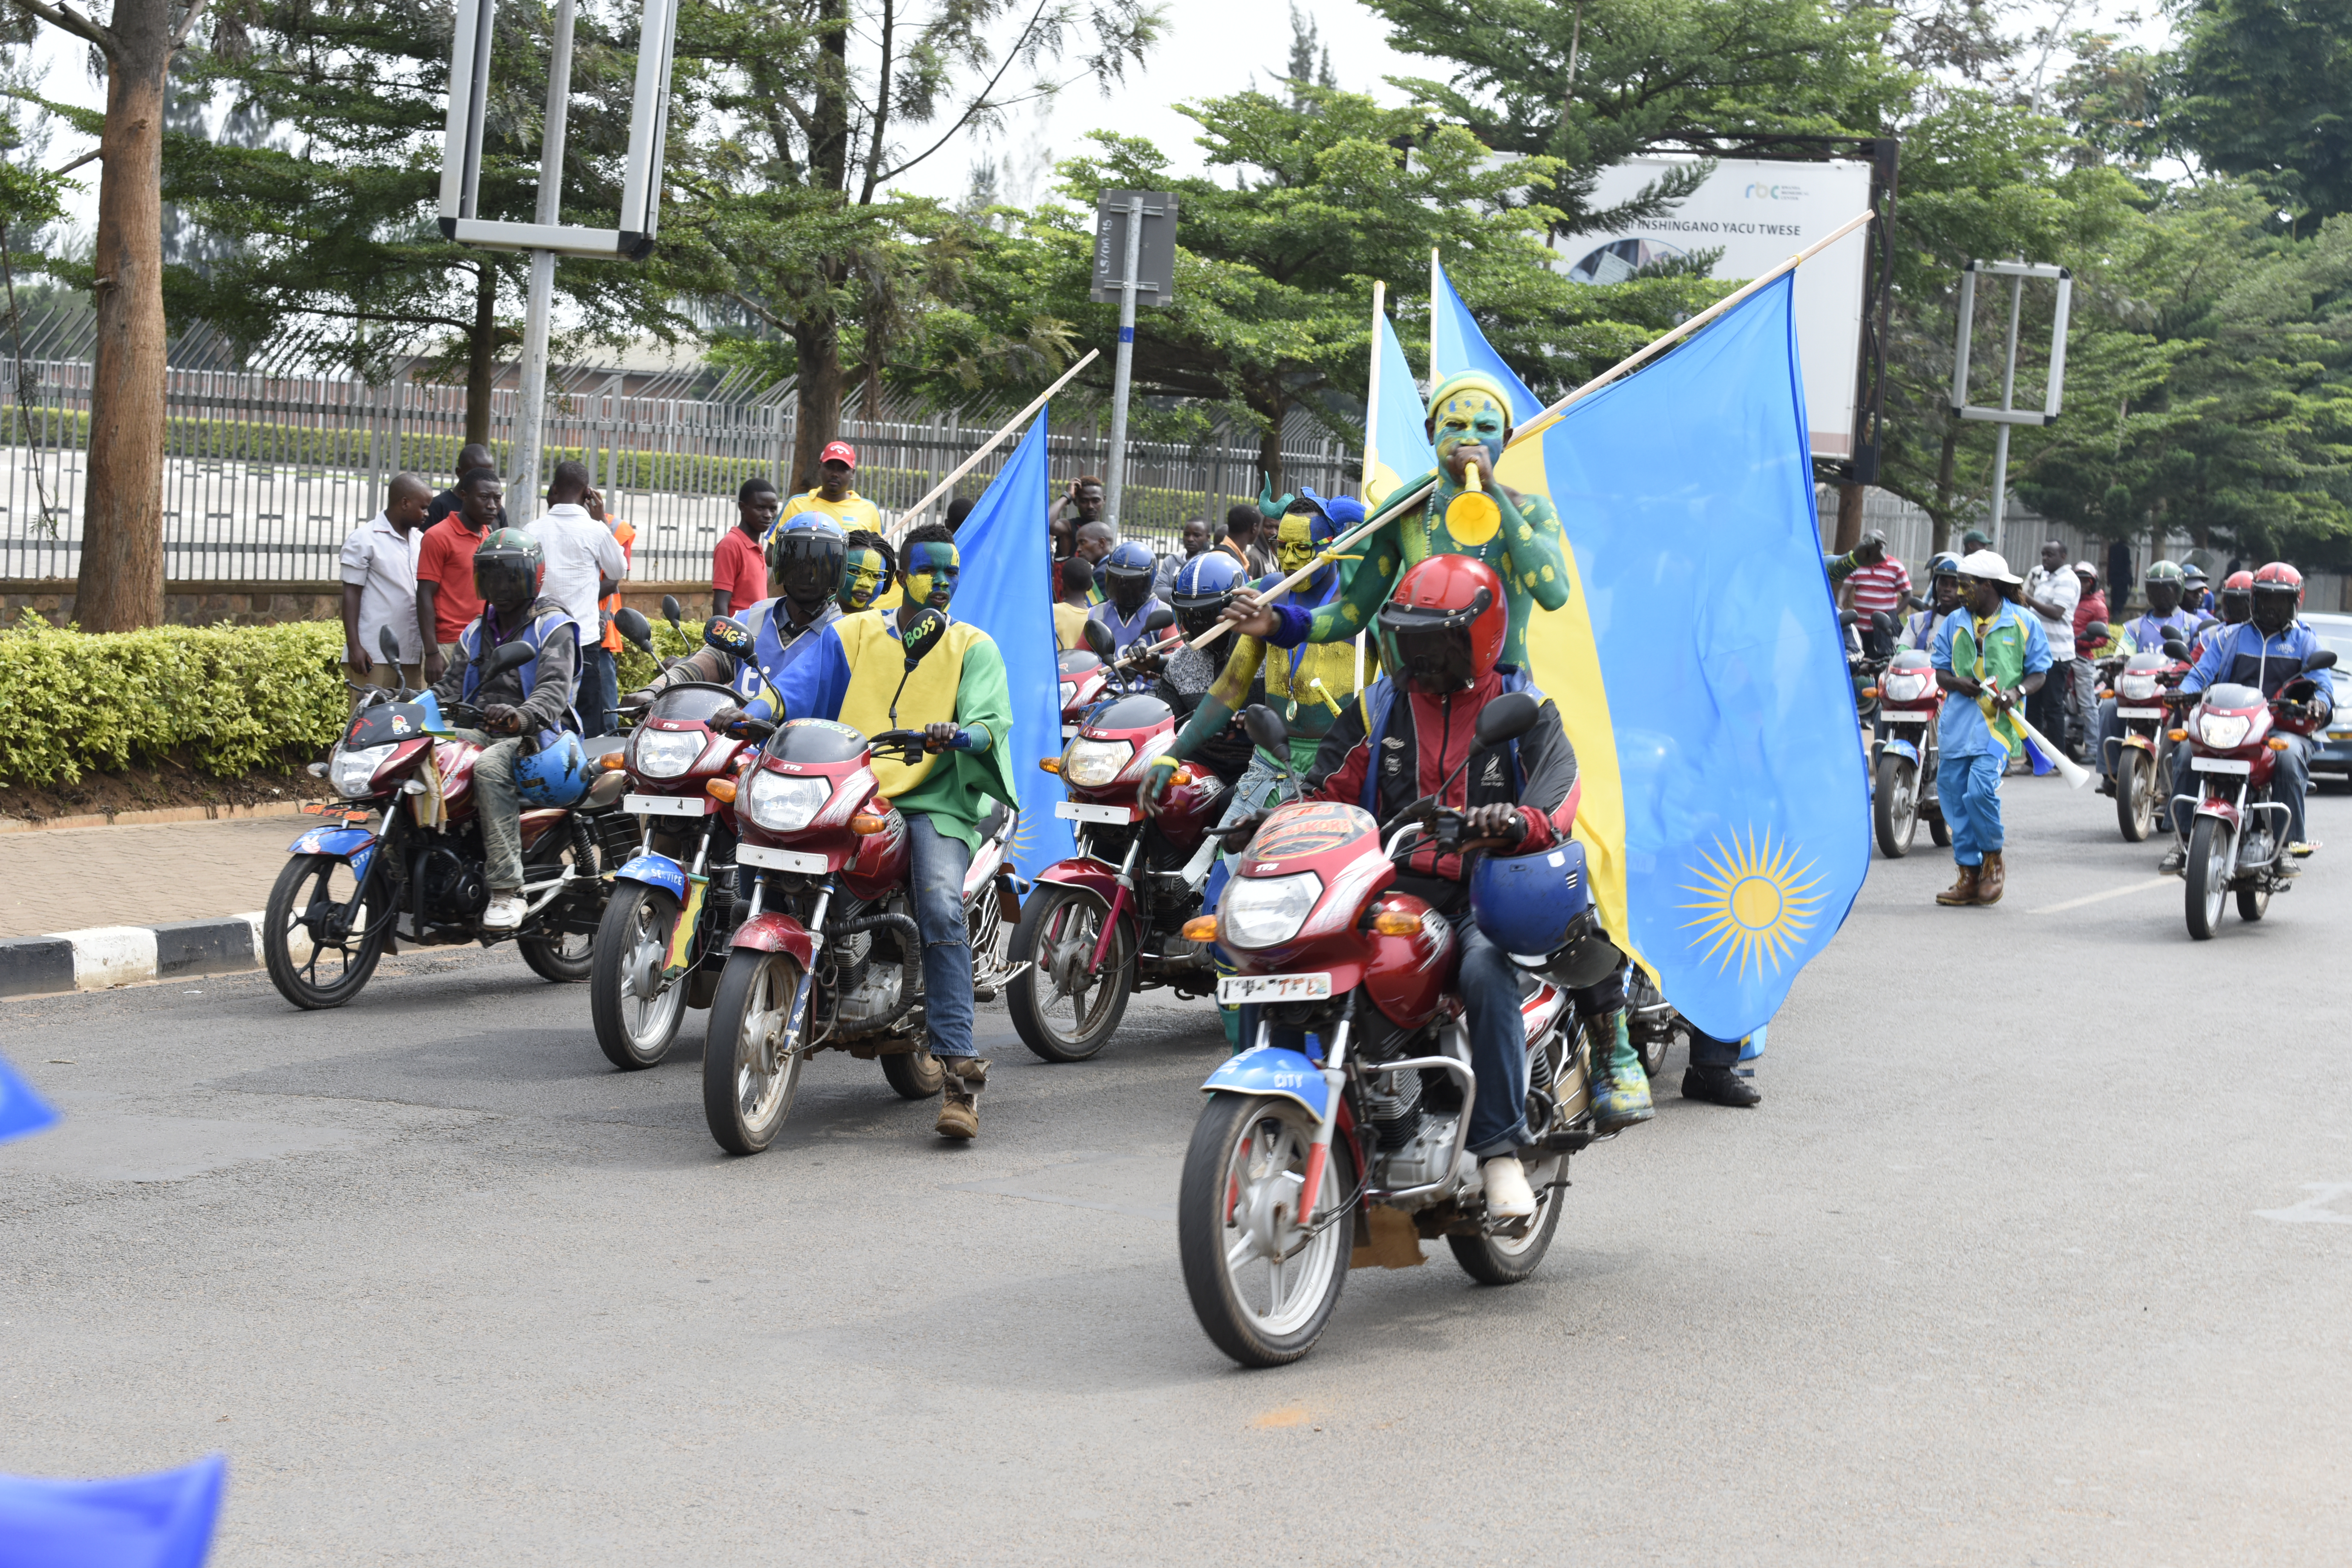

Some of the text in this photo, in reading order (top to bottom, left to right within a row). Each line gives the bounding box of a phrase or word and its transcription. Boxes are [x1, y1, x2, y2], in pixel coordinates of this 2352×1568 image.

[1745, 182, 1779, 199] rbc
[1638, 220, 1719, 232] INSHINGANO
[1722, 223, 1755, 234] YACU
[1759, 224, 1801, 236] TWESE
[904, 616, 936, 648] BOSS
[818, 721, 858, 738] BOSS
[351, 850, 370, 868] CITY
[1255, 863, 1280, 872] TVS
[1274, 1073, 1303, 1089] CITY
